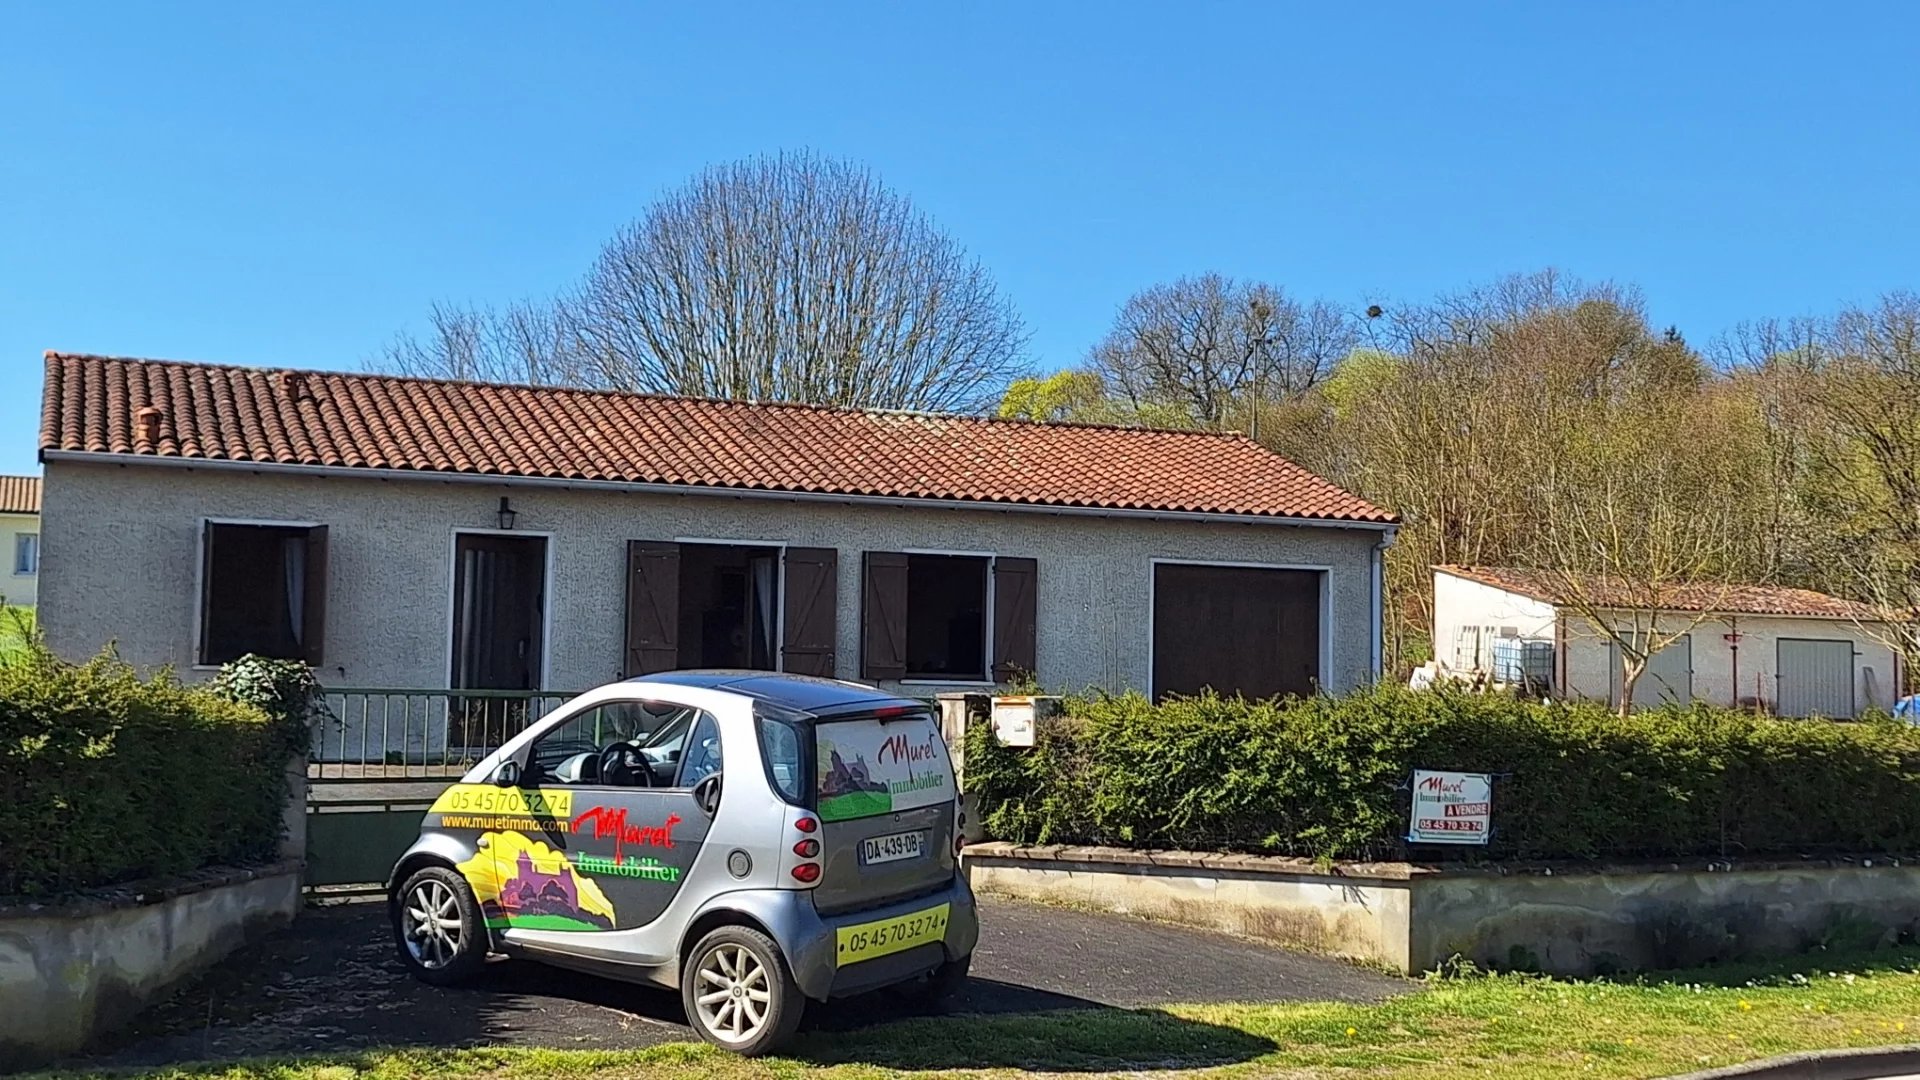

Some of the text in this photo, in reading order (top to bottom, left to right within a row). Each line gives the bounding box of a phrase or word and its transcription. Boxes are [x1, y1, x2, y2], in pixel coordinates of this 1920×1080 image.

[877, 730, 938, 784] Muret
[887, 770, 944, 795] Immobilier
[1419, 776, 1467, 803] Muret
[451, 792, 568, 814] 05 45 70 32 74
[1420, 792, 1467, 804] Immobilier
[1447, 804, 1487, 816] A VENDRE
[442, 815, 568, 832] www.muretimmo.com
[570, 806, 682, 866] Muret
[1420, 821, 1482, 830] 05 45 70 32 74
[866, 834, 918, 859] DA-439-DB
[577, 851, 680, 882] Immobilier
[850, 914, 938, 952] 05 45 70 32 74
